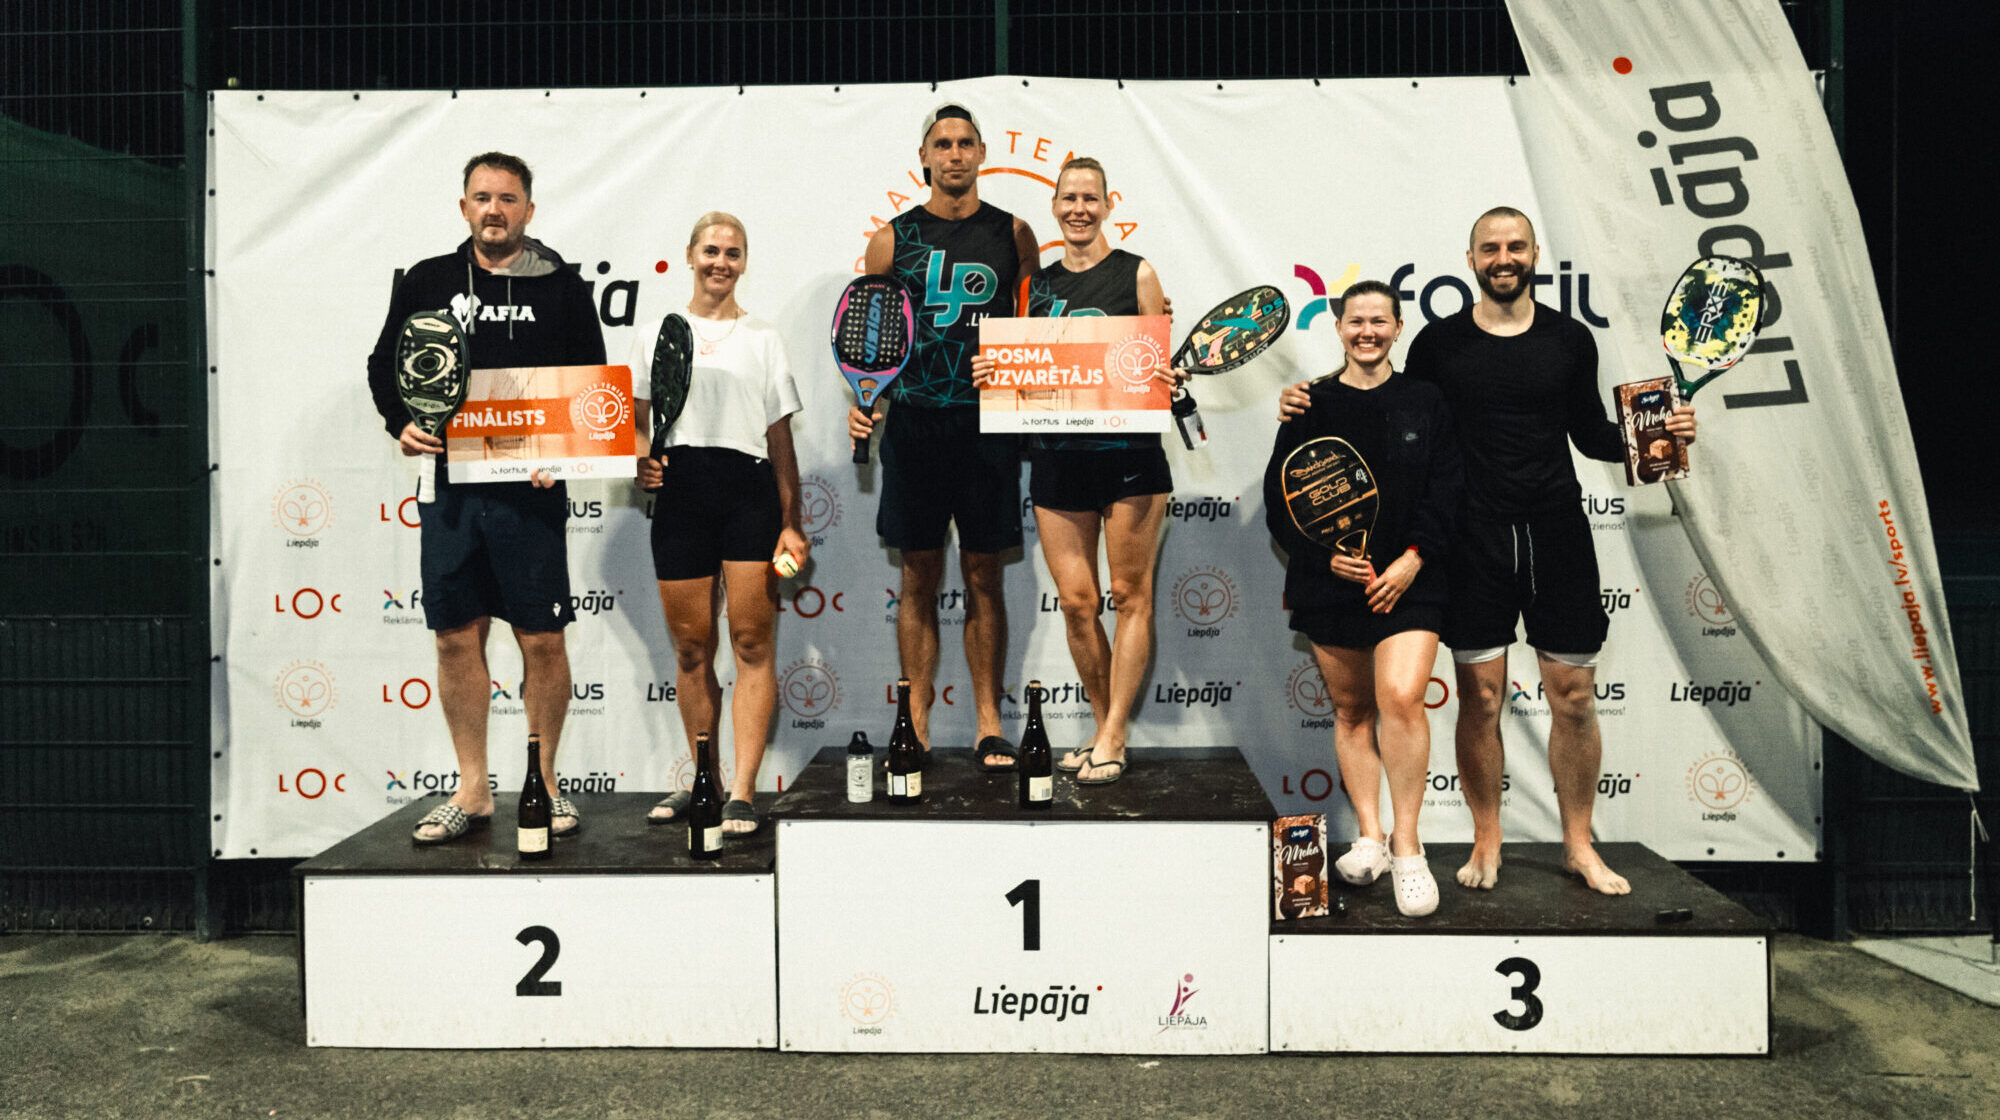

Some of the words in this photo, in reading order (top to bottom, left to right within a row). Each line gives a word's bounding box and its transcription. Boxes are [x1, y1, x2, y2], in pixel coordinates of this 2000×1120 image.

[1262, 296, 1284, 316] DS
[986, 348, 1054, 364] POSMA
[986, 364, 1104, 387] UZVARĒTĀJS
[452, 407, 546, 429] FINĀLISTS
[1309, 476, 1347, 499] GOLD
[1312, 482, 1351, 506] CLUB
[381, 496, 421, 529] LO
[1165, 496, 1231, 523] iepāja
[275, 587, 342, 620] LOC
[383, 677, 431, 710] LO
[1155, 682, 1233, 708] Liepāja
[1670, 681, 1752, 707] Liepāja
[279, 767, 346, 800] LOC
[1004, 879, 1041, 951] 1
[515, 925, 562, 996] 2
[974, 985, 1090, 1022] Liepāja
[1492, 956, 1544, 1031] 3
[1158, 1013, 1208, 1027] LIEPĀJA
